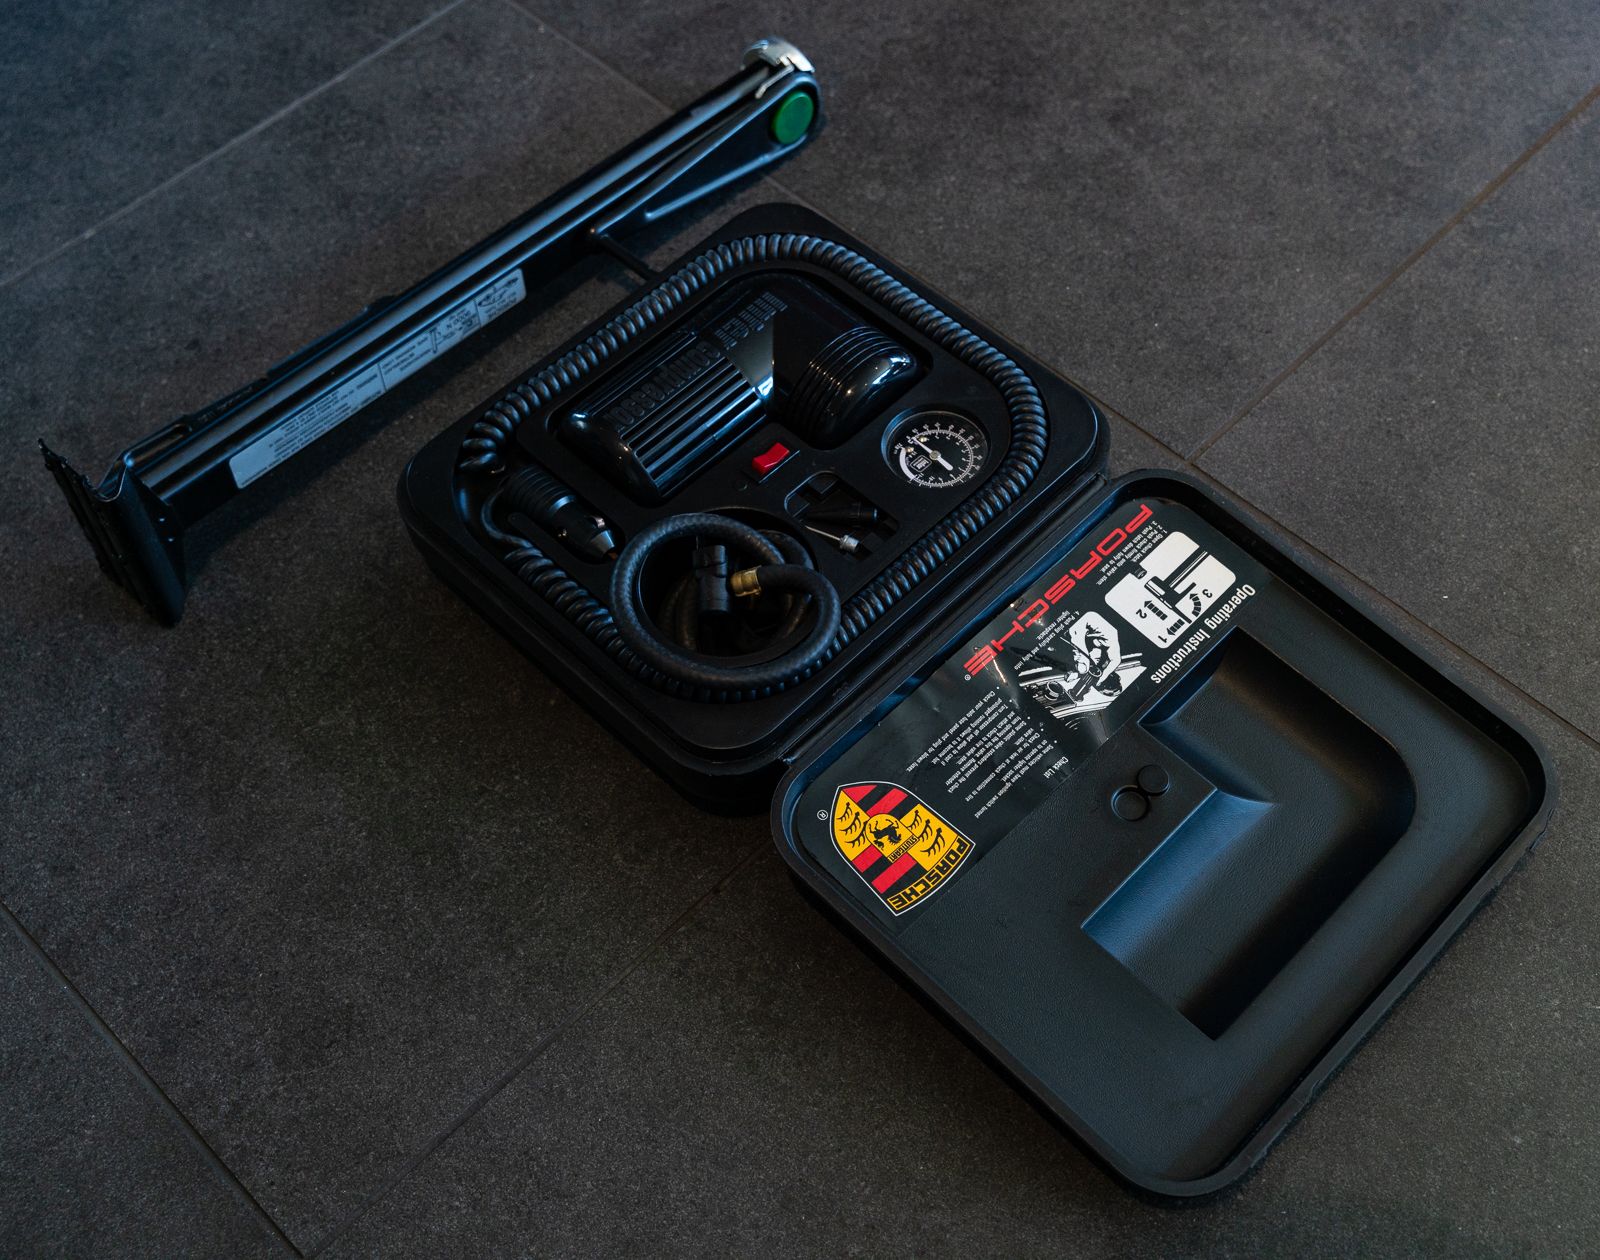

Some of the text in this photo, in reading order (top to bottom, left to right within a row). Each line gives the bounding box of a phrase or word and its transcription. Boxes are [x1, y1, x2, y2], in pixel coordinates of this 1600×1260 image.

[1141, 525, 1153, 535] Push
[1147, 529, 1158, 539] Push
[1132, 534, 1143, 543] latch
[1136, 538, 1148, 549] chuck
[1152, 533, 1163, 544] Open
[1122, 542, 1133, 553] down
[1141, 542, 1153, 553] chuck
[1113, 551, 1124, 560] fully
[1124, 548, 1138, 559] firmly
[1131, 552, 1143, 562] latch.
[1100, 563, 1110, 573] seal.
[1116, 558, 1126, 567] onto
[1106, 566, 1117, 576] valve
[1096, 575, 1108, 585] stem.
[964, 504, 1153, 675] PORSCHE
[1202, 589, 1213, 598] 3
[1135, 609, 1147, 619] 2
[1036, 610, 1070, 640] lighter receptacle.
[1063, 615, 1076, 625] Push
[1054, 623, 1065, 634] plug
[1150, 584, 1256, 684] Operating Instructions
[1038, 632, 1056, 648] carefully
[1158, 635, 1167, 643] 1
[1031, 646, 1040, 655] and
[1022, 653, 1033, 662] fully
[1014, 661, 1024, 670] into
[983, 691, 996, 702] Check
[974, 700, 984, 710] your
[984, 697, 1002, 717] prolonged
[997, 704, 1009, 713] Turn
[966, 709, 975, 718] auto
[1007, 711, 1015, 720] and
[958, 716, 968, 725] fuse
[970, 714, 985, 728] running
[979, 711, 999, 731] compressor
[996, 717, 1008, 729] attach
[1011, 716, 1022, 725] from
[1014, 720, 1027, 731] Some
[948, 723, 960, 735] panel
[959, 726, 972, 738] allows
[986, 727, 998, 738] chuck
[996, 723, 1012, 737] opening
[941, 732, 949, 741] and
[966, 734, 974, 742] and
[1003, 729, 1016, 742] plastic
[1014, 728, 1034, 746] valve stem.
[1028, 732, 1040, 743] Check
[932, 738, 943, 748] plug
[957, 740, 967, 750] allow
[975, 740, 984, 748] tire
[984, 741, 993, 749] tire
[994, 740, 1005, 749] valve
[938, 744, 954, 758] become
[966, 746, 977, 756] valve
[975, 747, 986, 757] valve.
[977, 748, 996, 765] extenders
[1009, 752, 1019, 760] leak
[1024, 748, 1038, 761] operate
[916, 752, 929, 763] blown
[931, 756, 940, 764] hot.
[944, 753, 953, 763] cool
[956, 755, 967, 765] stem.
[906, 762, 918, 772] fuses.
[960, 757, 976, 772] Remove
[995, 762, 1006, 773] chuck
[1013, 759, 1027, 771] lighter
[1043, 756, 1069, 779] Check List
[964, 763, 979, 778] prevent
[1001, 769, 1015, 782] socket.
[945, 770, 961, 786] extender
[974, 744, 1054, 818] Some vehicles must have ignition switch turned
[976, 772, 996, 791] connection
[947, 782, 960, 793] chuck
[965, 794, 974, 802] tire
[888, 835, 919, 863] STUTTGART
[889, 836, 970, 912] PORSCHE
